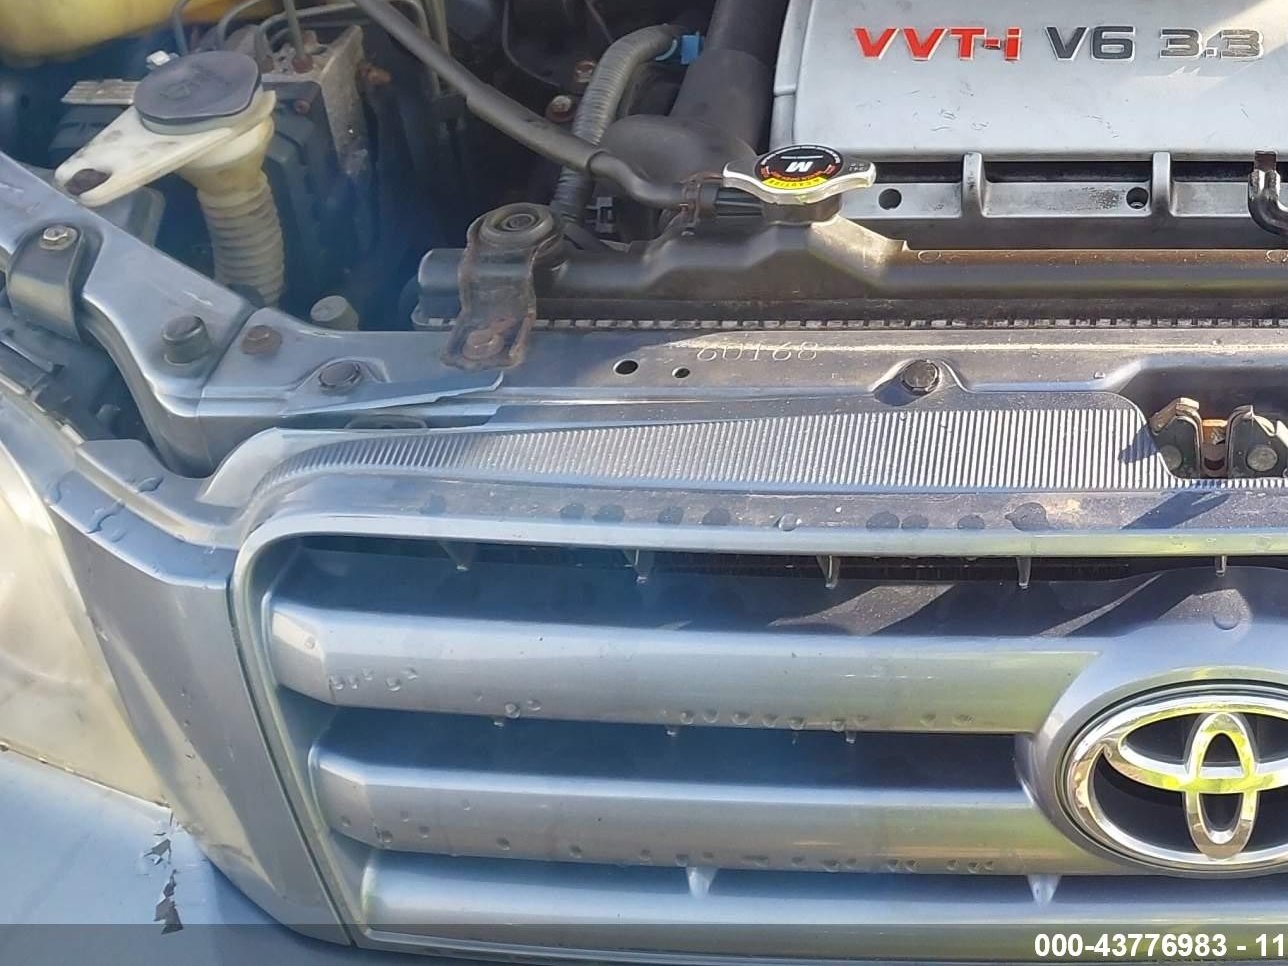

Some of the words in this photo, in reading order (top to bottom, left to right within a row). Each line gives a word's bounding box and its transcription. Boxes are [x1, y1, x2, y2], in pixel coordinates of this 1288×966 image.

[853, 26, 1022, 61] VVT-i
[1044, 26, 1137, 61] V6
[1158, 28, 1264, 60] 3.3
